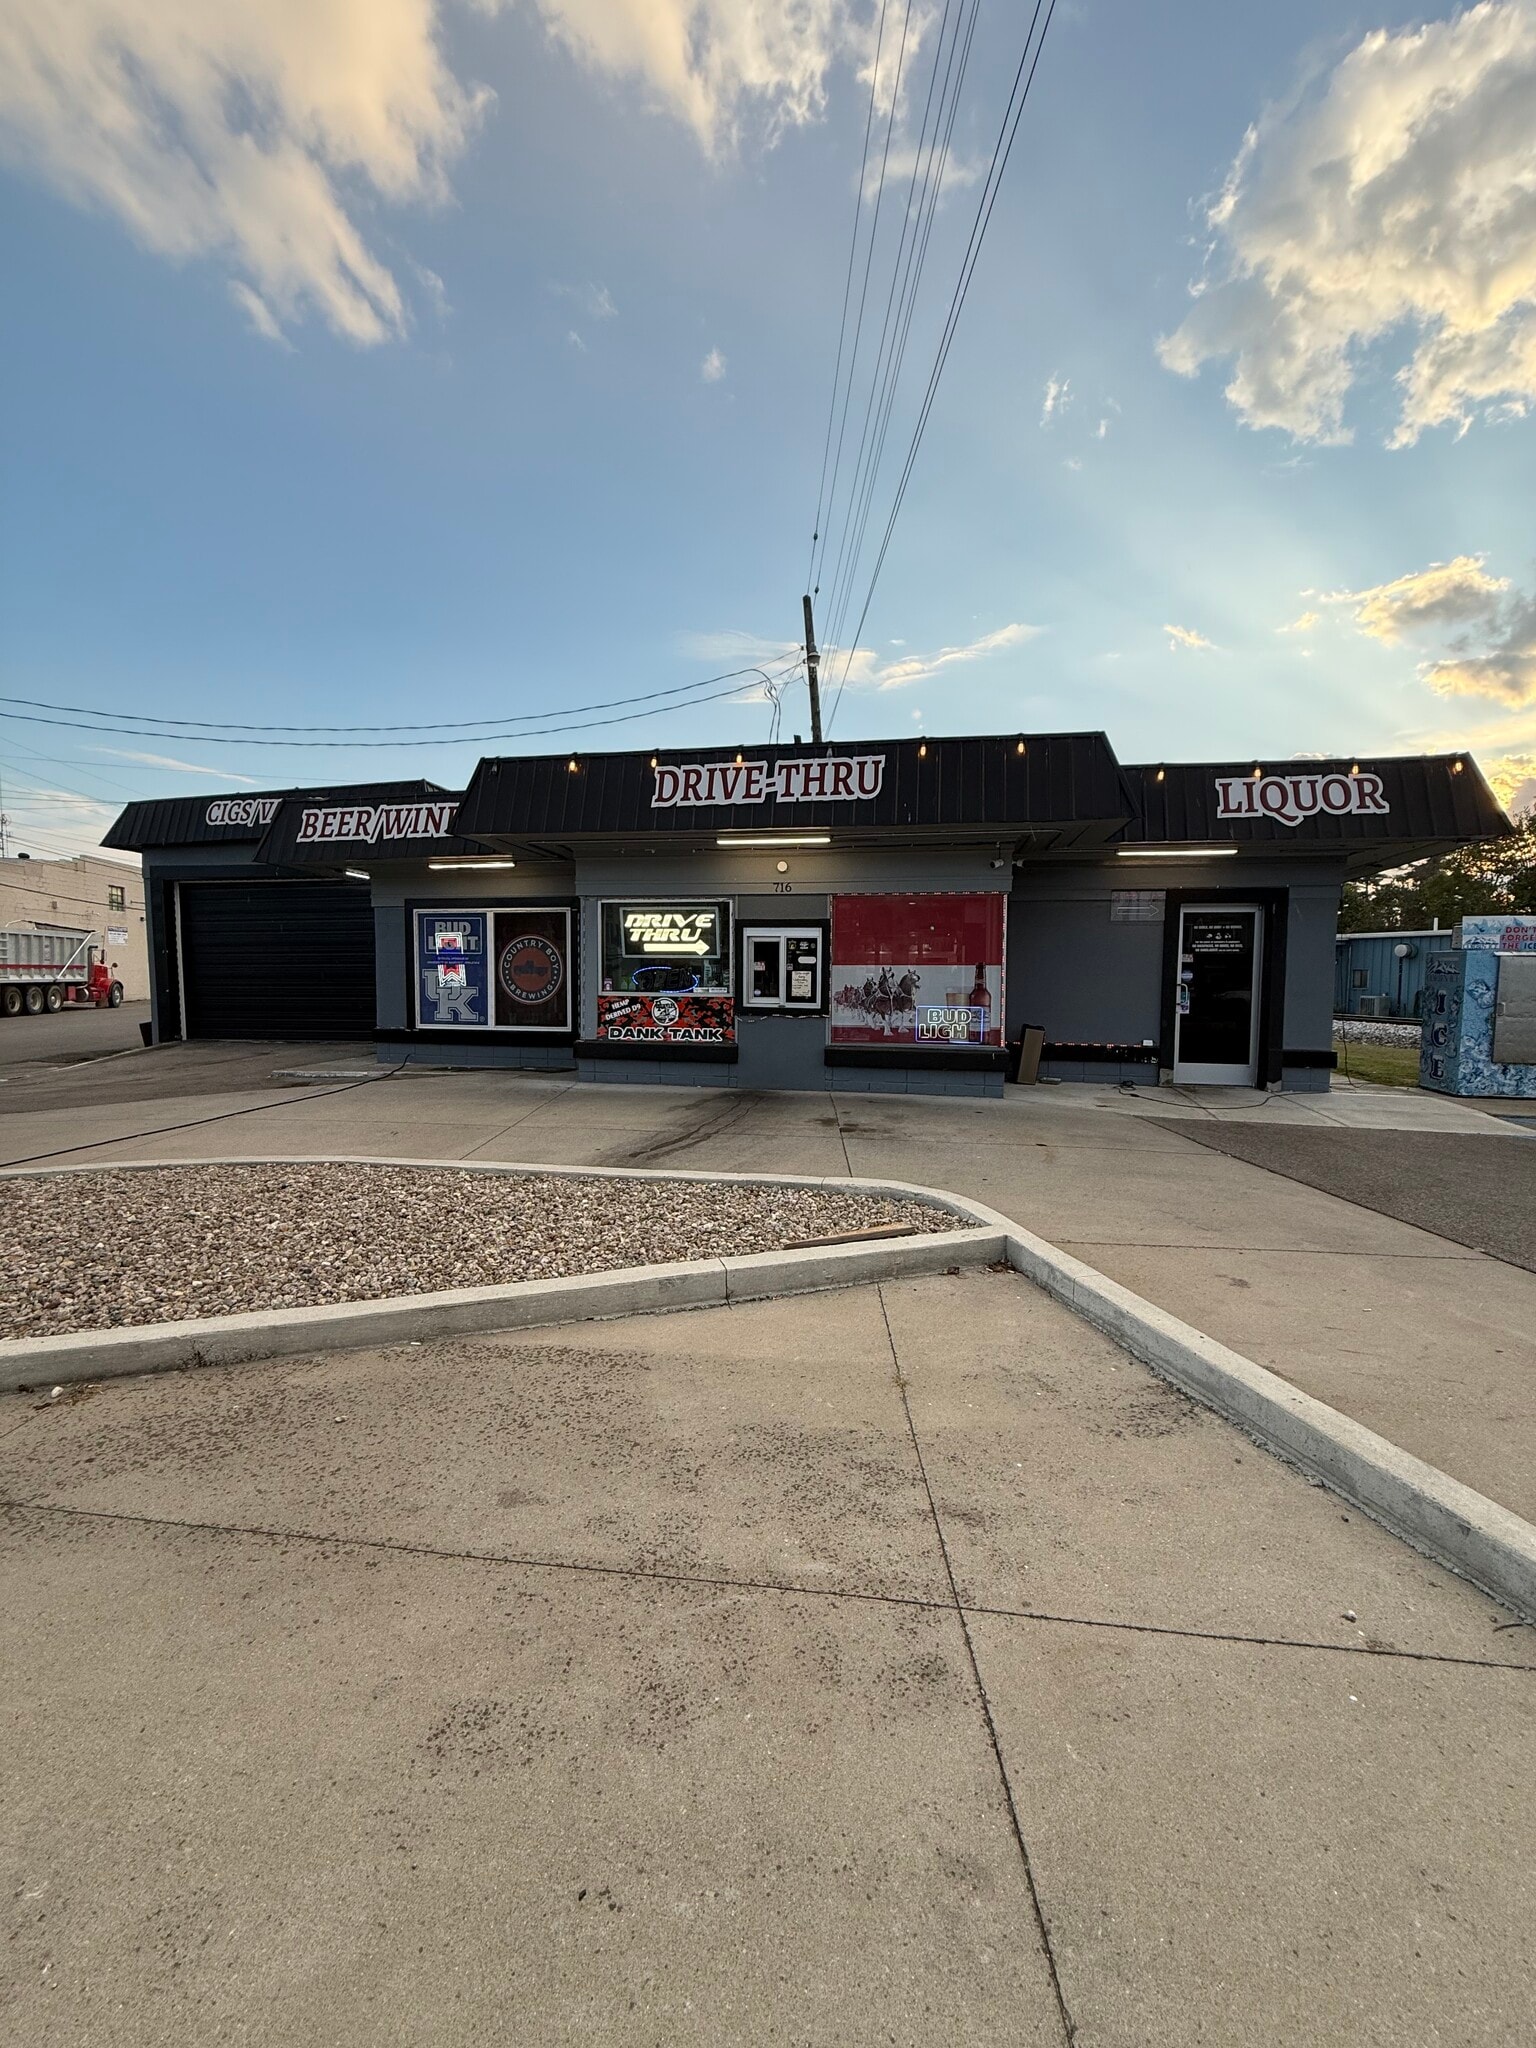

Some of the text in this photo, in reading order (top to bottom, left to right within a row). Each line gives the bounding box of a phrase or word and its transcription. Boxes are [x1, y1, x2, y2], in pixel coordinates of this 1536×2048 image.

[653, 759, 883, 804] DRIVE-THRU
[1217, 776, 1387, 824] LIQUOR
[773, 883, 792, 893] 716
[624, 913, 715, 928] DRIVE
[434, 921, 471, 935] BUD
[629, 928, 702, 941] THRU
[504, 940, 559, 969] COUNTRY BOY
[510, 983, 553, 999] BREWING
[611, 998, 630, 1010] HEMP
[605, 1007, 631, 1020] DERIVED
[928, 1008, 972, 1024] BUD
[609, 1027, 722, 1041] DANK TANK
